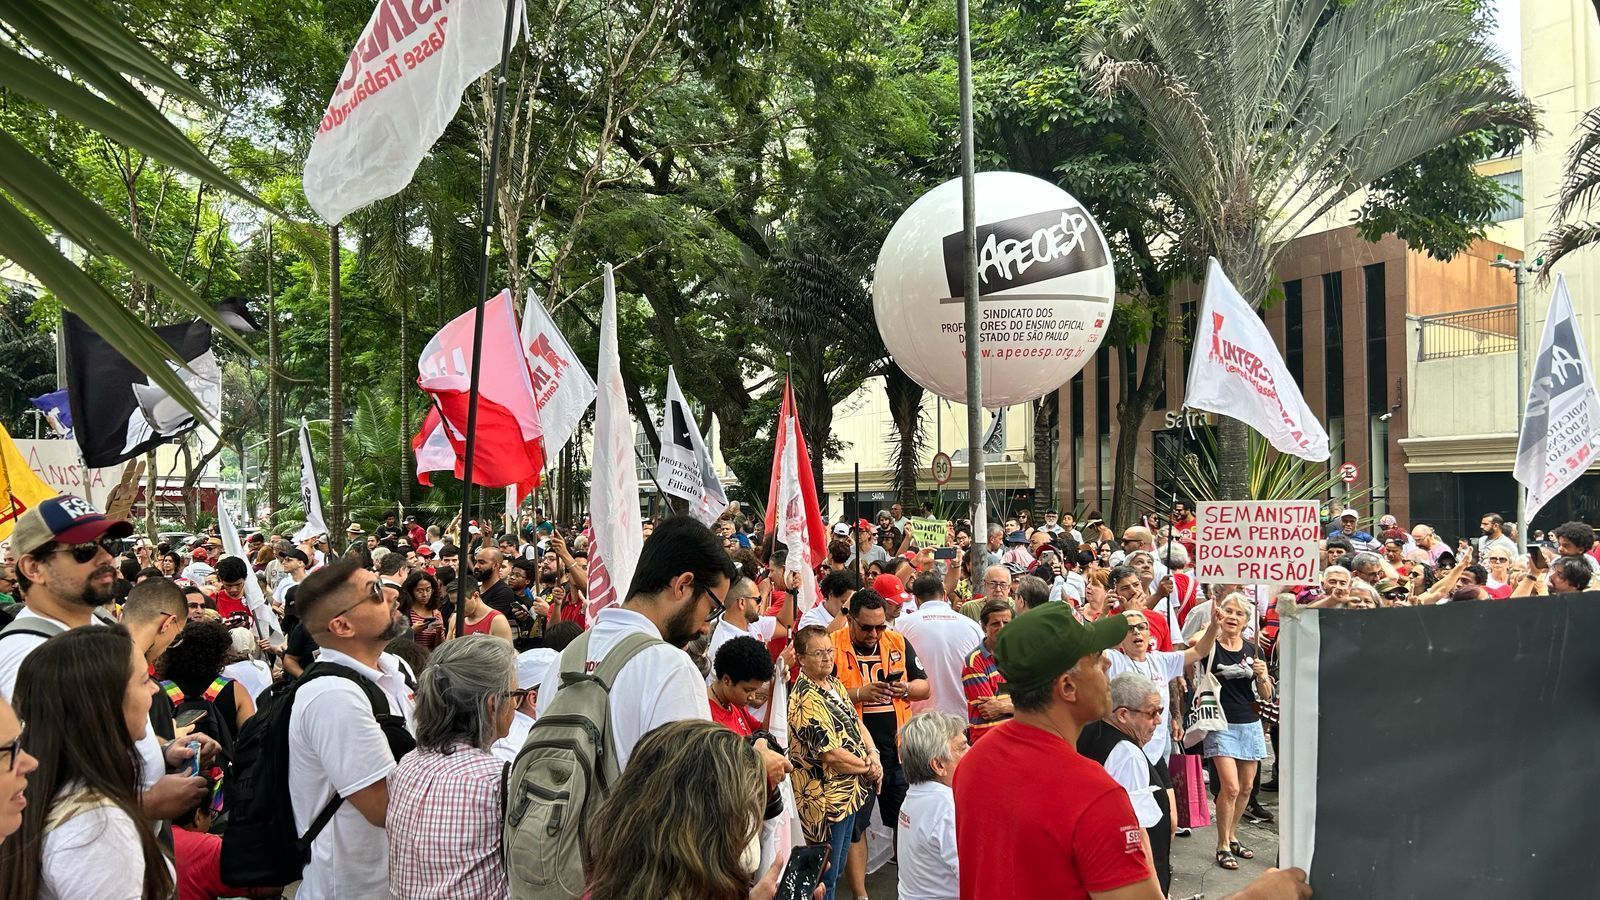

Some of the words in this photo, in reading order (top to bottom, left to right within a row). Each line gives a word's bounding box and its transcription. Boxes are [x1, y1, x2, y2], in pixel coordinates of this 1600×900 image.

[977, 212, 1087, 284] APEOESP
[983, 308, 1033, 319] SINDICATO
[1035, 308, 1053, 318] DOS
[1010, 321, 1023, 330] DO
[1025, 321, 1056, 330] ENSINO
[1058, 320, 1085, 331] OFICIAL
[979, 333, 1010, 342] STADO
[1012, 332, 1024, 341] DE
[1026, 329, 1044, 341] SÃO
[1044, 331, 1069, 341] PAULO
[1165, 410, 1209, 429] Safra
[936, 462, 948, 474] 50
[667, 478, 698, 496] Filiado
[1205, 506, 1250, 523] SEM
[1254, 506, 1317, 524] ANISTIA
[1202, 526, 1241, 541] SEM
[1249, 525, 1318, 542] PERDÃO!
[1199, 545, 1304, 560] BOLSONARO
[1201, 564, 1224, 577] NA
[1237, 559, 1314, 583] PRISÃO!
